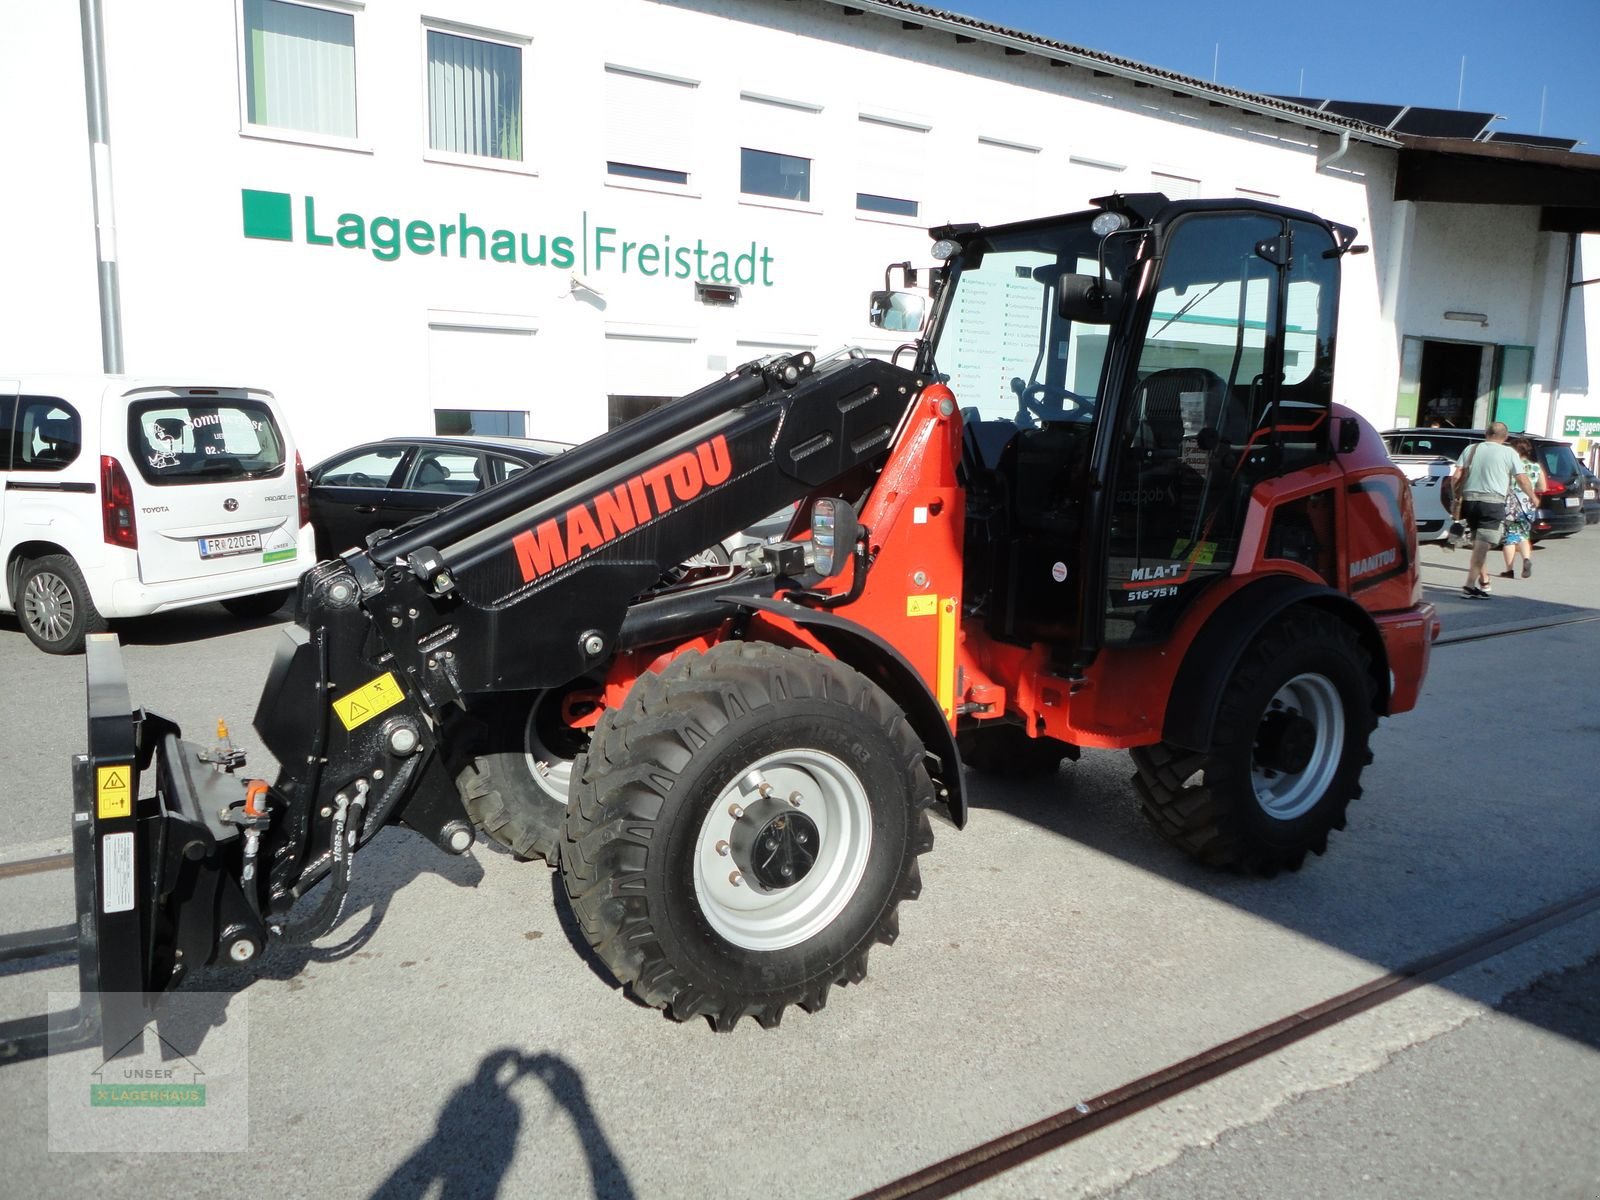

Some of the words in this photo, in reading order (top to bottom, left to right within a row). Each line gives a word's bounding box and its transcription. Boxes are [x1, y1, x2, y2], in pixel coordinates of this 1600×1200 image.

[304, 195, 576, 269] Lagerhaus
[595, 226, 775, 288] Freistadt
[184, 414, 263, 432] Sommst
[1565, 419, 1576, 432] SB
[142, 506, 170, 514] TOYOTA
[511, 433, 733, 584] MANITOU
[208, 540, 221, 552] FR
[1349, 547, 1396, 578] MANITOU
[1131, 564, 1181, 581] MLA-T
[1127, 588, 1167, 602] 516-75
[1169, 586, 1178, 596] H
